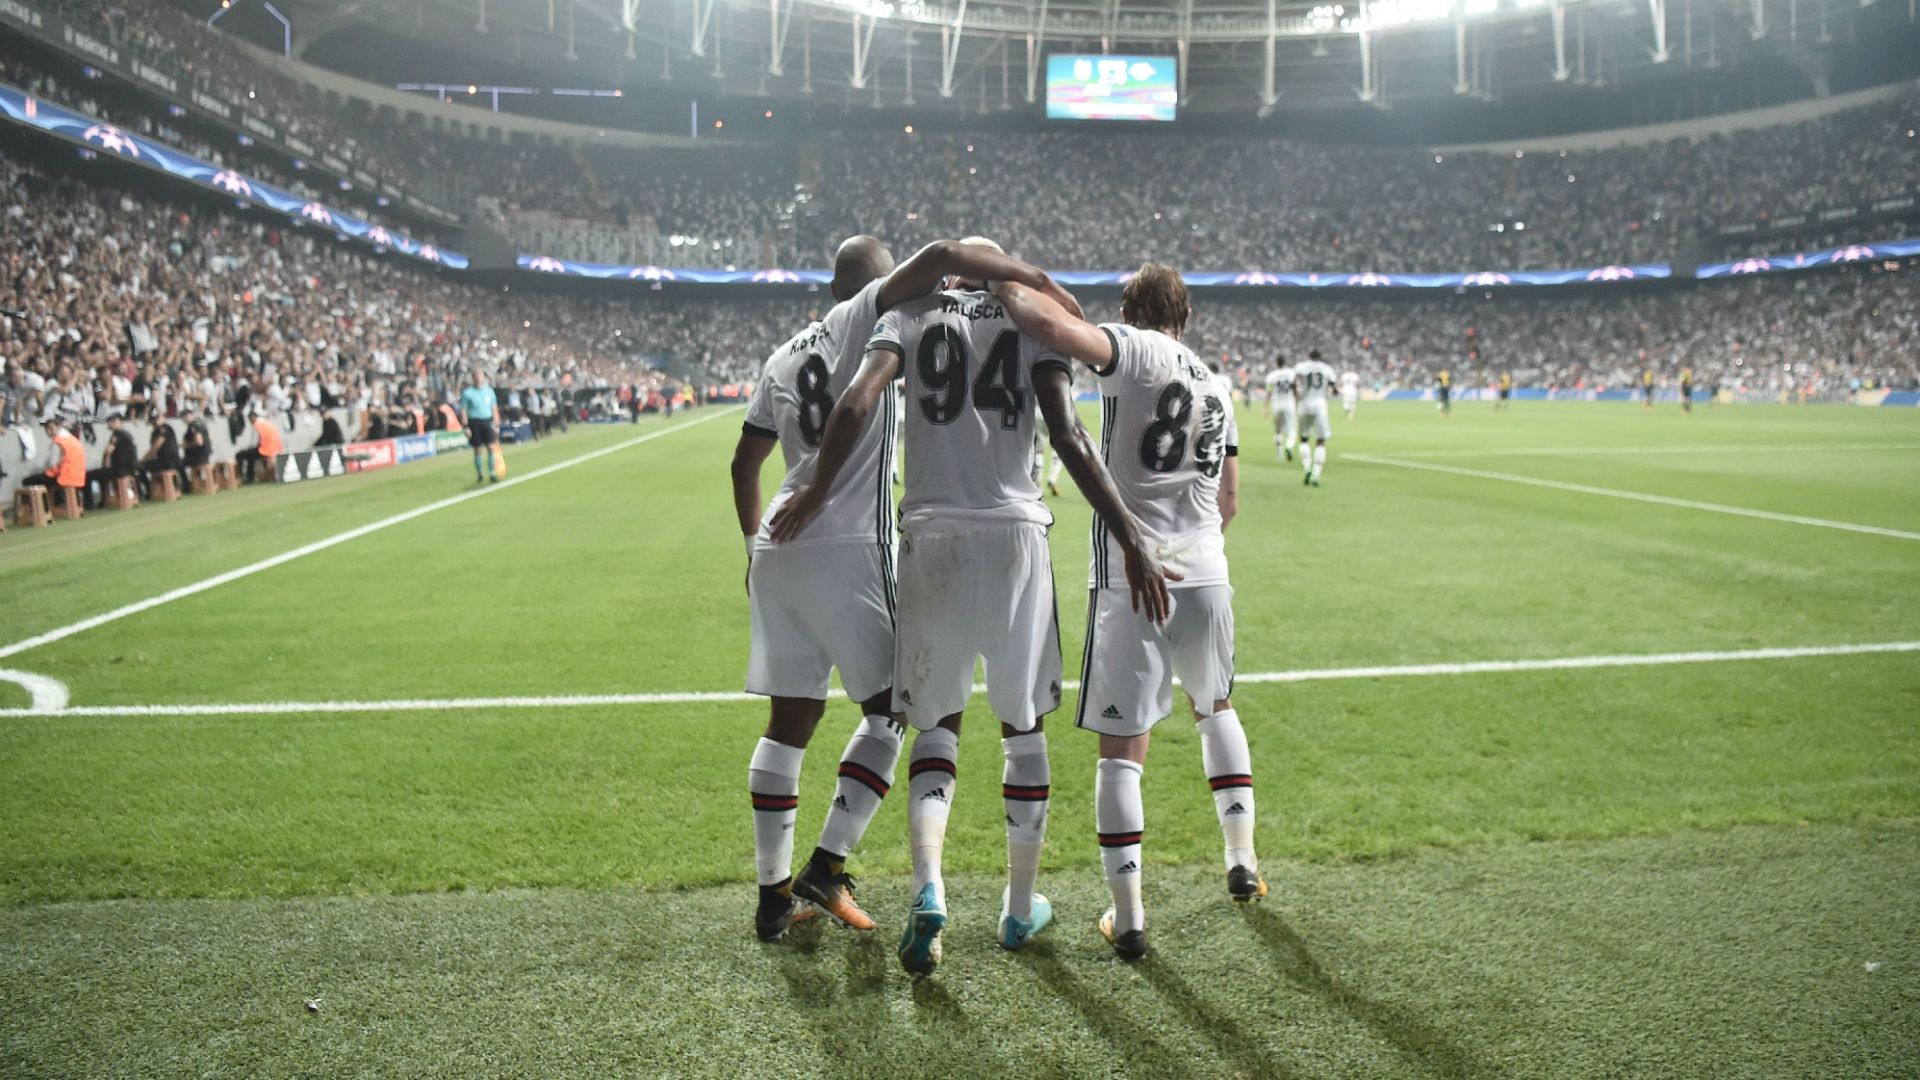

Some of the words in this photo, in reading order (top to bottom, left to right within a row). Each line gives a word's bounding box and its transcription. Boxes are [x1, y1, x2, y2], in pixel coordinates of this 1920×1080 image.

[942, 299, 1004, 320] TALISCA
[796, 353, 836, 449] 8
[918, 322, 1025, 431] 94
[1138, 380, 1225, 478] 88
